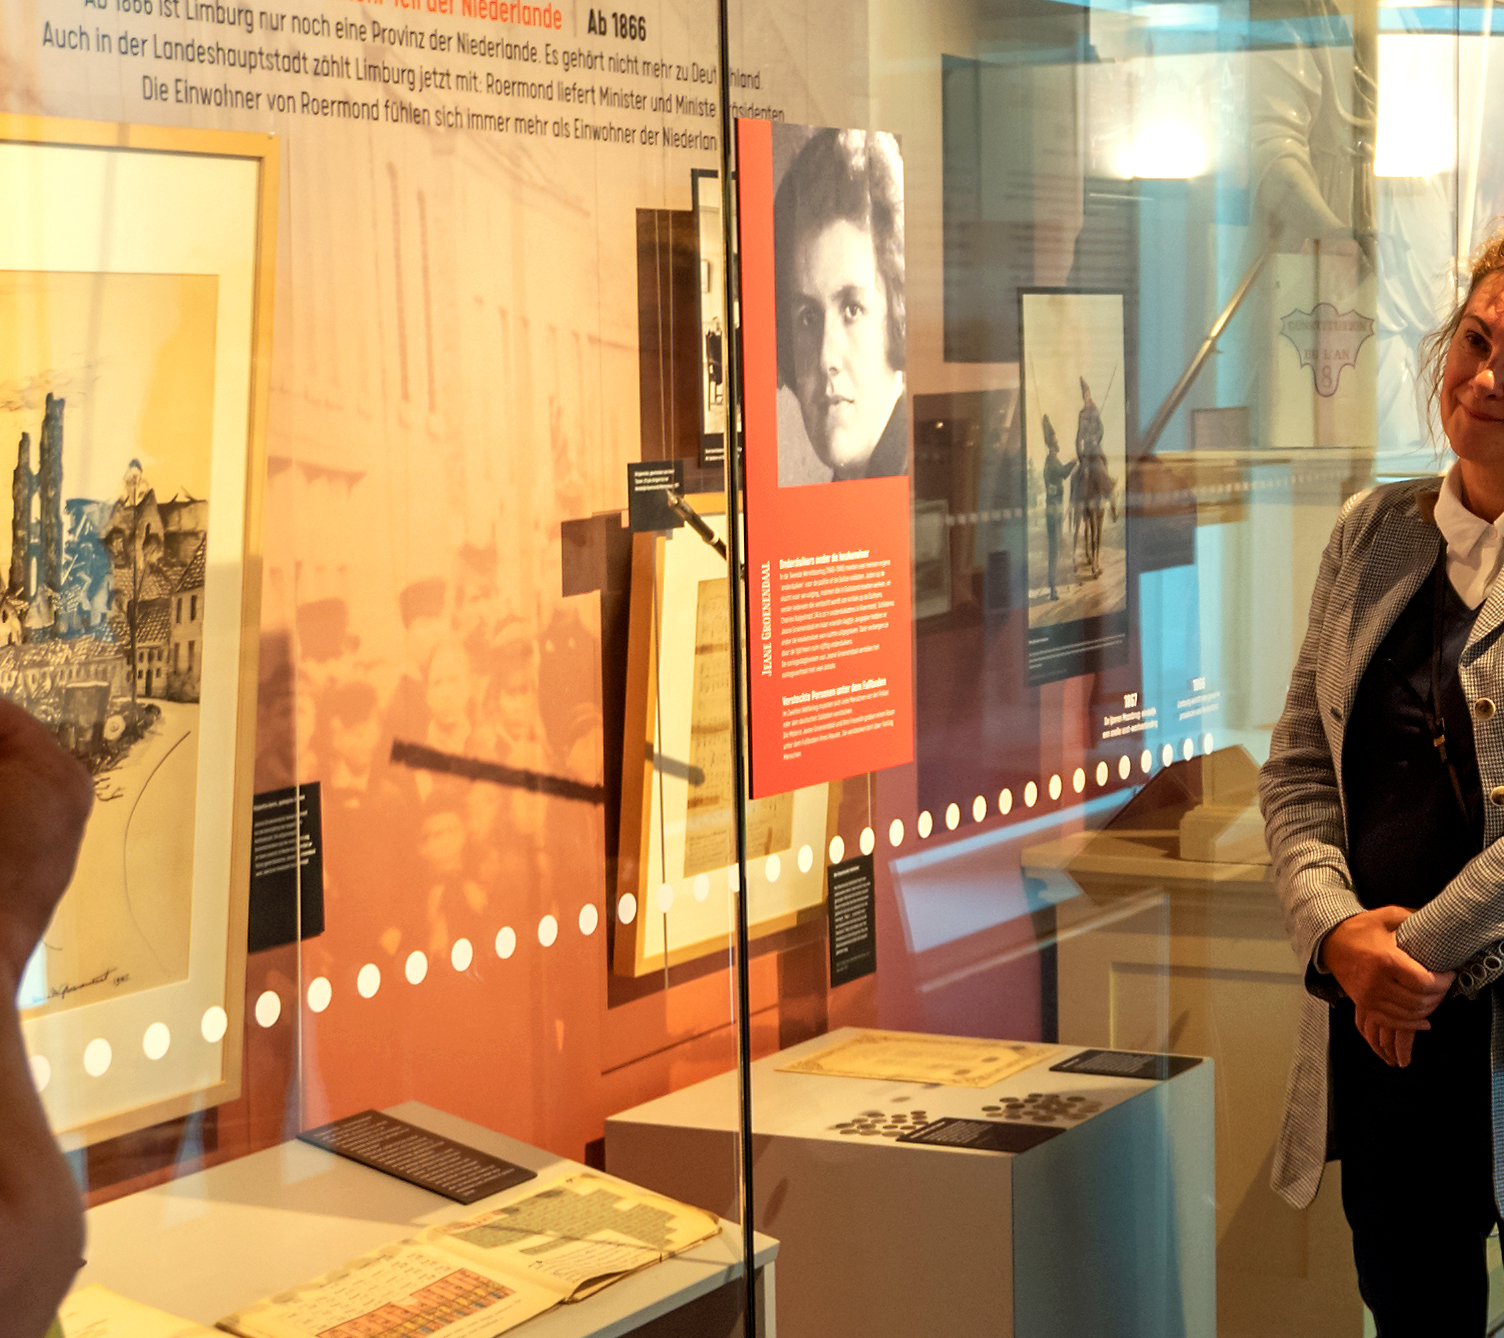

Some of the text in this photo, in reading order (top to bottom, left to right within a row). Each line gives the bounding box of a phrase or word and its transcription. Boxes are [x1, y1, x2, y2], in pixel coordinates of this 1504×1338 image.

[259, 10, 287, 31] nur
[291, 13, 331, 37] noch
[335, 16, 367, 42] eine
[371, 20, 426, 49] Provinz
[428, 28, 453, 52] der
[456, 31, 541, 63] Niederlande.
[544, 42, 559, 65] Es
[561, 47, 605, 72] gehört
[608, 52, 639, 75] nicht
[642, 58, 673, 78] mehr
[675, 64, 689, 82] zu
[587, 8, 608, 37] Ab
[611, 12, 647, 42] 1866
[42, 20, 90, 51] Auch
[96, 27, 112, 53] in
[117, 30, 147, 57] der
[153, 33, 309, 75] Landeshauptstadt
[355, 57, 416, 92] Limburg
[418, 65, 452, 93] jetzt
[455, 70, 482, 93] mit:
[486, 71, 554, 101] Roermond
[557, 81, 596, 106] liefert
[599, 86, 649, 110] Minister
[650, 94, 673, 114] und
[141, 74, 169, 102] Die
[174, 77, 262, 110] Einwohner
[266, 93, 297, 113] von
[300, 90, 380, 121] Roermond
[383, 98, 431, 125] fühlen
[434, 104, 463, 129] sich
[467, 108, 511, 133] immer
[514, 114, 549, 135] mehr
[552, 116, 570, 138] als
[573, 117, 637, 144] Einwohner
[639, 125, 660, 146] der
